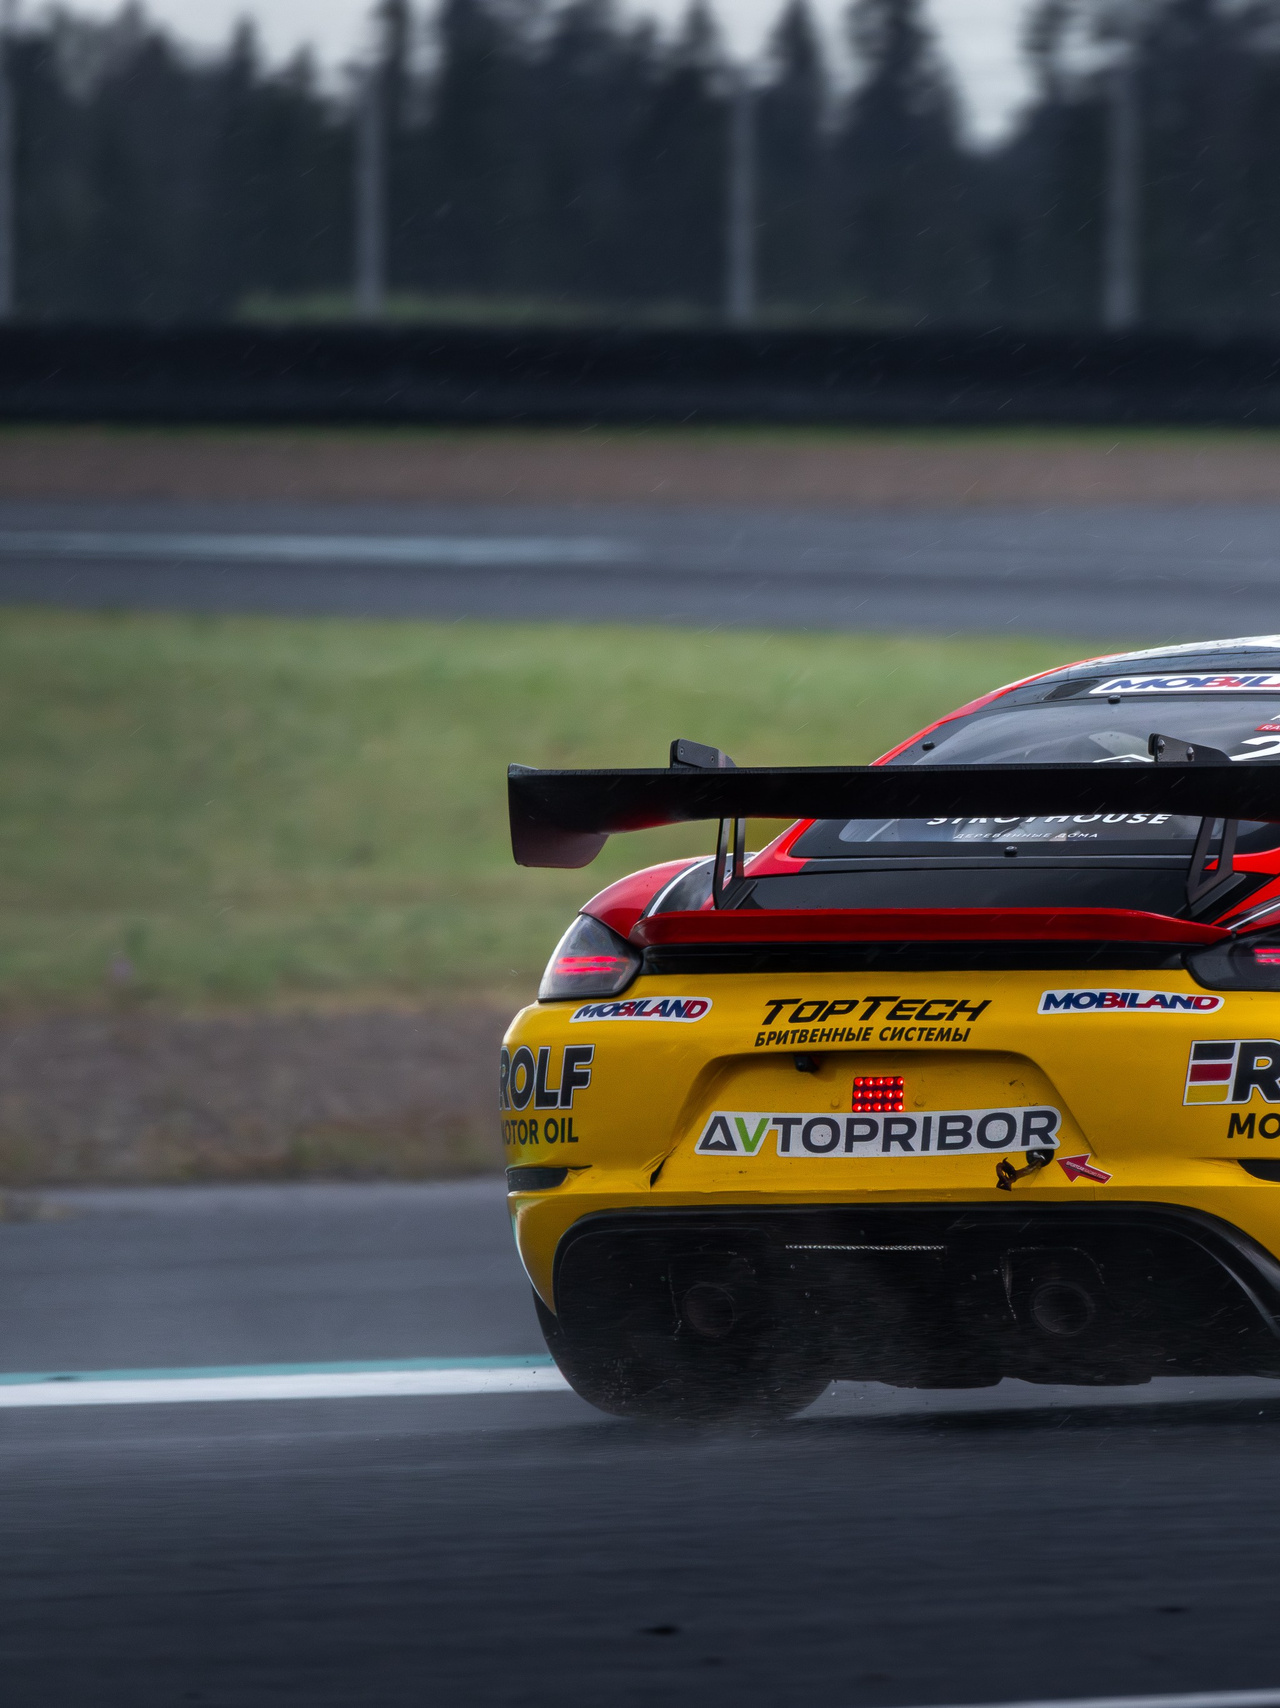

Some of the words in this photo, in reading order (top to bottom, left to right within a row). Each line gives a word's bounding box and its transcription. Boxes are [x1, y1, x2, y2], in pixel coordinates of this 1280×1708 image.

[573, 999, 709, 1019] MOBILAND
[1041, 991, 1221, 1011] MOBILAND
[754, 1026, 874, 1047] БРИТВЕННЫЕ
[879, 1026, 972, 1043] СИСТЕМЫ
[543, 1116, 579, 1144] OIL
[698, 1110, 1058, 1153] AVTOPRIBOR
